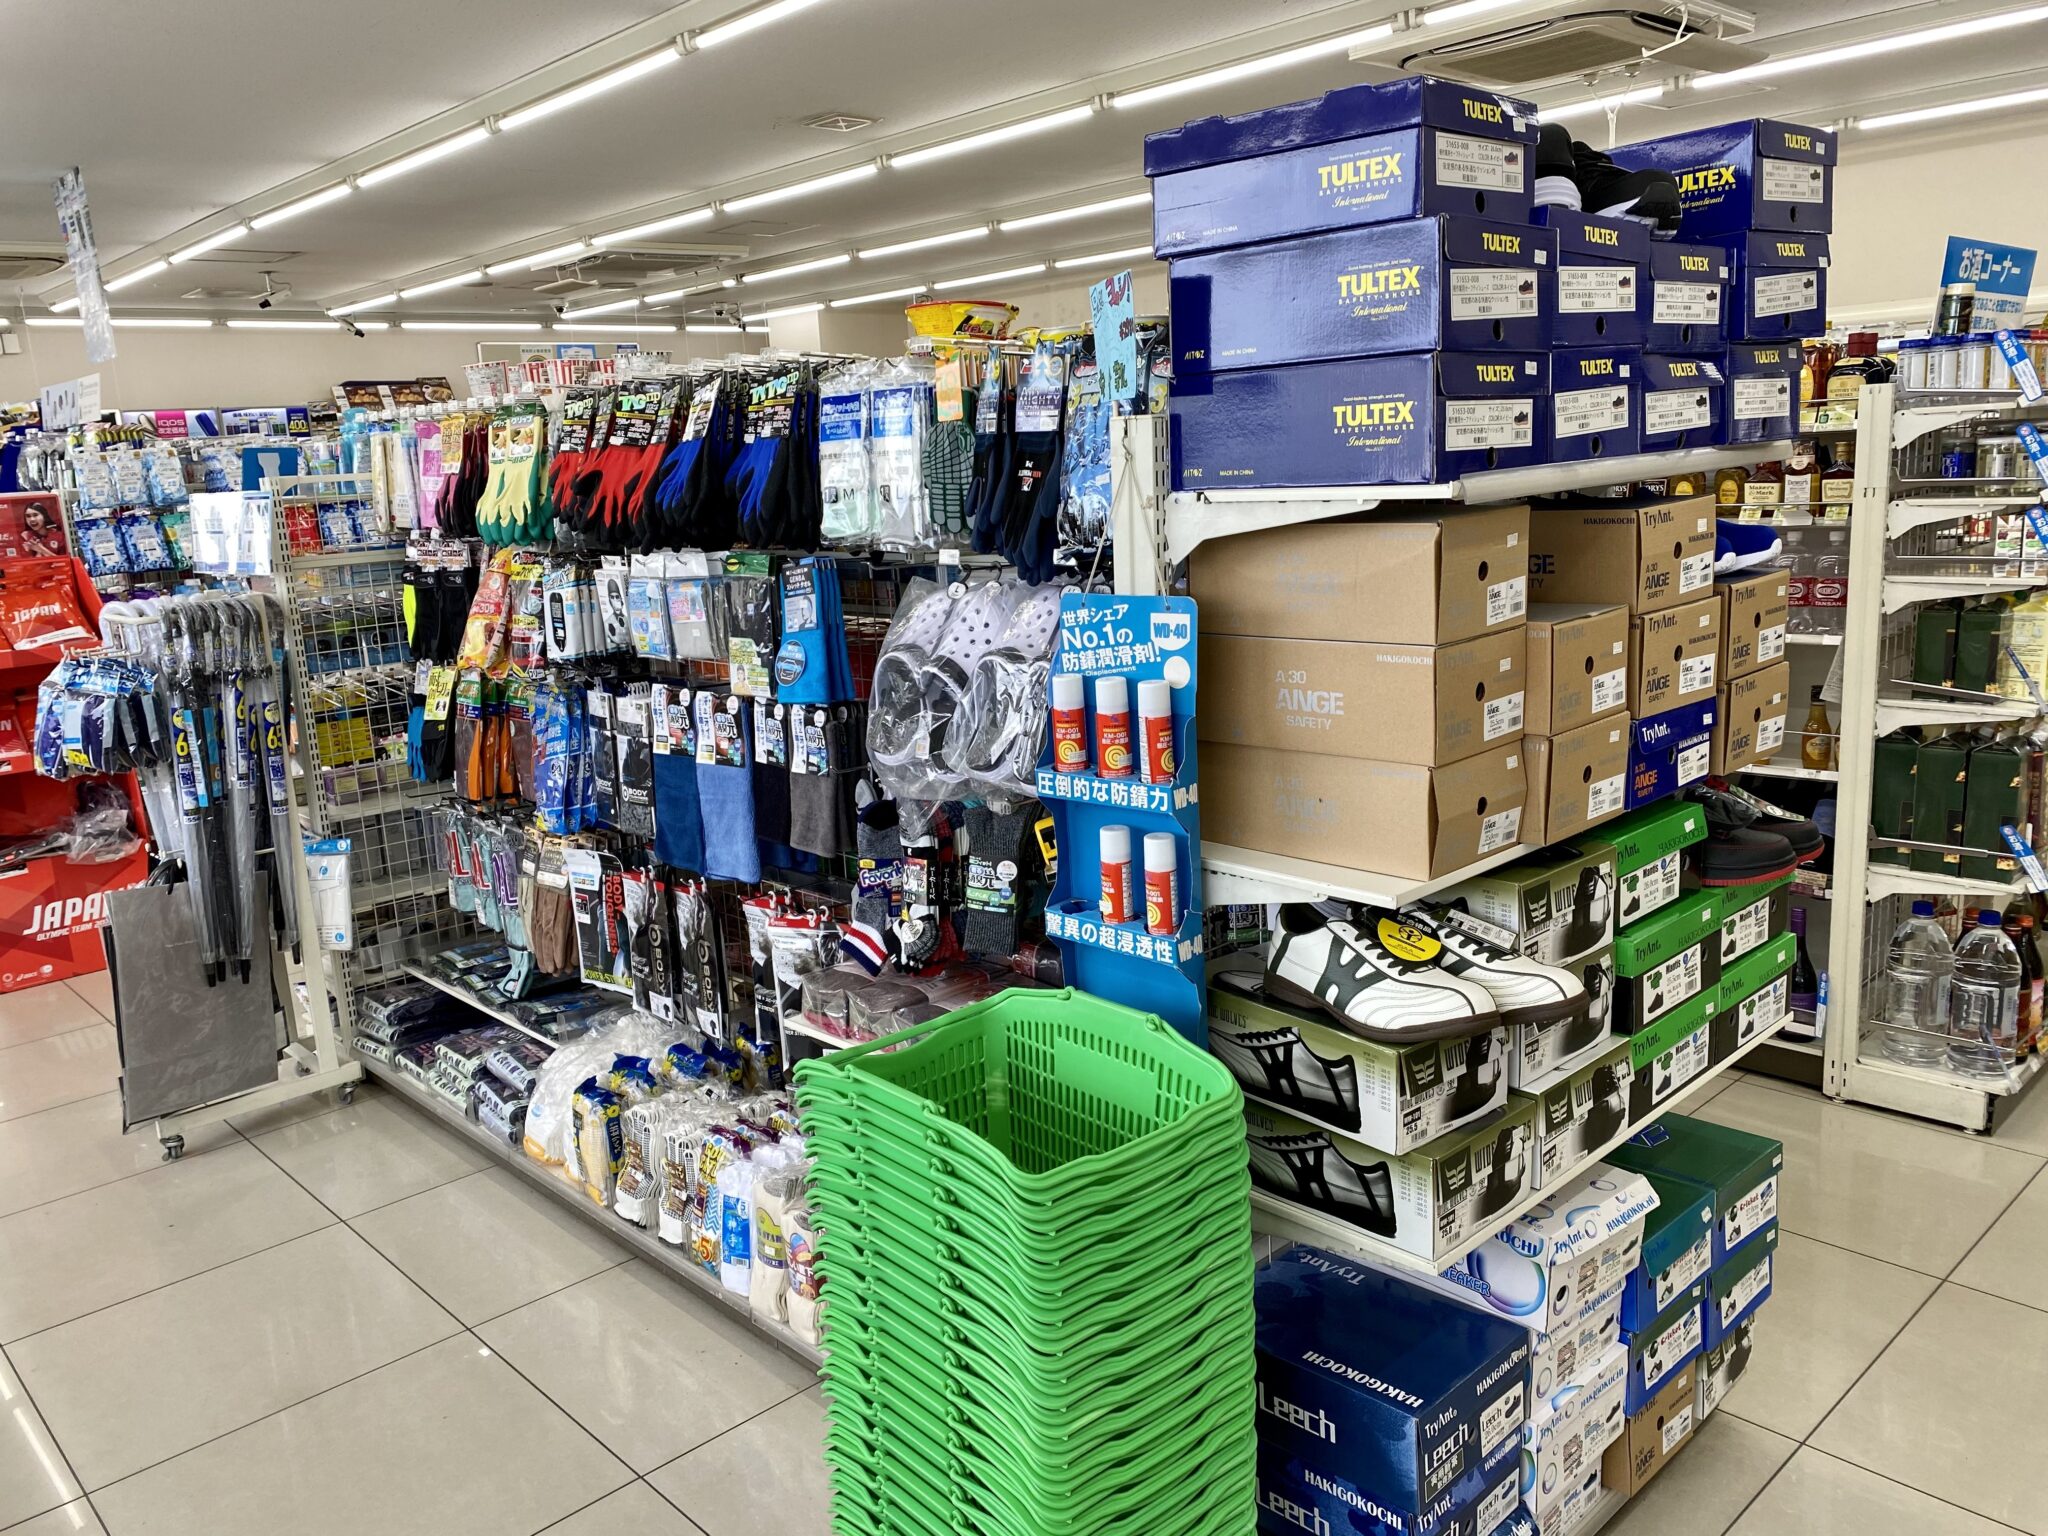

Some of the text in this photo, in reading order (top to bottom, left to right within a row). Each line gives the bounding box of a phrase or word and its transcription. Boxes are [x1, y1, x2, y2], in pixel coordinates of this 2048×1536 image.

[1462, 98, 1503, 124] TULTEX
[1784, 133, 1810, 151] TULTEX
[1318, 152, 1402, 189] TULTEX
[1675, 165, 1736, 193] ULTEX
[1332, 190, 1389, 208] International
[1482, 232, 1520, 254] TULTEX
[1584, 226, 1618, 246] TULTEX
[1776, 243, 1805, 257] TULTEX
[1680, 255, 1709, 271] TULTEX
[1958, 247, 2021, 284] お酒コーナー
[1337, 265, 1421, 298] TULTEX
[1351, 301, 1409, 318] International
[1754, 350, 1780, 363] TULTEX
[1476, 364, 1514, 383] TULTEX
[1580, 359, 1613, 376] TULTEX
[1668, 363, 1698, 377] TULTEX
[1019, 394, 1060, 406] MIGHTY
[158, 419, 185, 427] IQOS
[1333, 401, 1415, 427] TULTEX
[1346, 435, 1402, 447] International
[1240, 468, 1254, 476] CHINA
[1583, 516, 1636, 525] HAKIGOKOCHI
[1528, 553, 1556, 575] GE
[1650, 562, 1658, 572] 30
[1644, 572, 1670, 591] ANGE
[1647, 590, 1665, 600] SAFETY
[12, 602, 61, 625] JAPAN
[1062, 603, 1129, 628] 世界シェア
[1061, 623, 1134, 650] No.1の
[1153, 622, 1188, 640] WD-40
[1376, 653, 1433, 667] HAKIGOKOCHI
[1732, 642, 1751, 662] ANGE
[1275, 670, 1307, 684] A 30
[1651, 666, 1658, 676] 30
[1645, 674, 1670, 695] ANGE
[1275, 688, 1345, 716] ANGE
[1648, 690, 1666, 704] SAFETY
[1285, 715, 1332, 731] SAFETY
[1641, 722, 1671, 743] TryAnt
[1730, 735, 1750, 753] ANGE
[1634, 770, 1658, 790] ANGE
[628, 787, 648, 797] BODY
[1038, 772, 1169, 811] 圧倒的な防錆力
[1174, 782, 1198, 810] WD-40
[1637, 786, 1654, 798] SAFETY
[1617, 842, 1639, 864] ryAnt
[1642, 864, 1659, 879] Mantis
[605, 876, 620, 958] TOUGHNESS
[36, 922, 93, 942] OLYMPIC TEAM
[1046, 912, 1174, 965] 驚異の超浸透性
[1178, 934, 1203, 963] WD-40
[655, 949, 667, 995] BODY
[1665, 959, 1681, 975] Mantis
[702, 965, 715, 1013] BODY
[1675, 1039, 1691, 1053] Mantis
[1574, 1080, 1592, 1108] WID
[1405, 1122, 1418, 1135] 25.5
[1605, 1195, 1656, 1233] HAKIGOKOCHI
[1554, 1229, 1583, 1254] TryAnt
[1302, 1350, 1424, 1408] HAKIGOKOCHI
[1258, 1380, 1337, 1444] Leech
[1482, 1408, 1502, 1433] Leech
[1424, 1406, 1454, 1440] TryAnt
[1425, 1422, 1469, 1477] Leech
[1256, 1477, 1331, 1536] Leech
[1304, 1469, 1402, 1531] HAKIGOKOCHI
